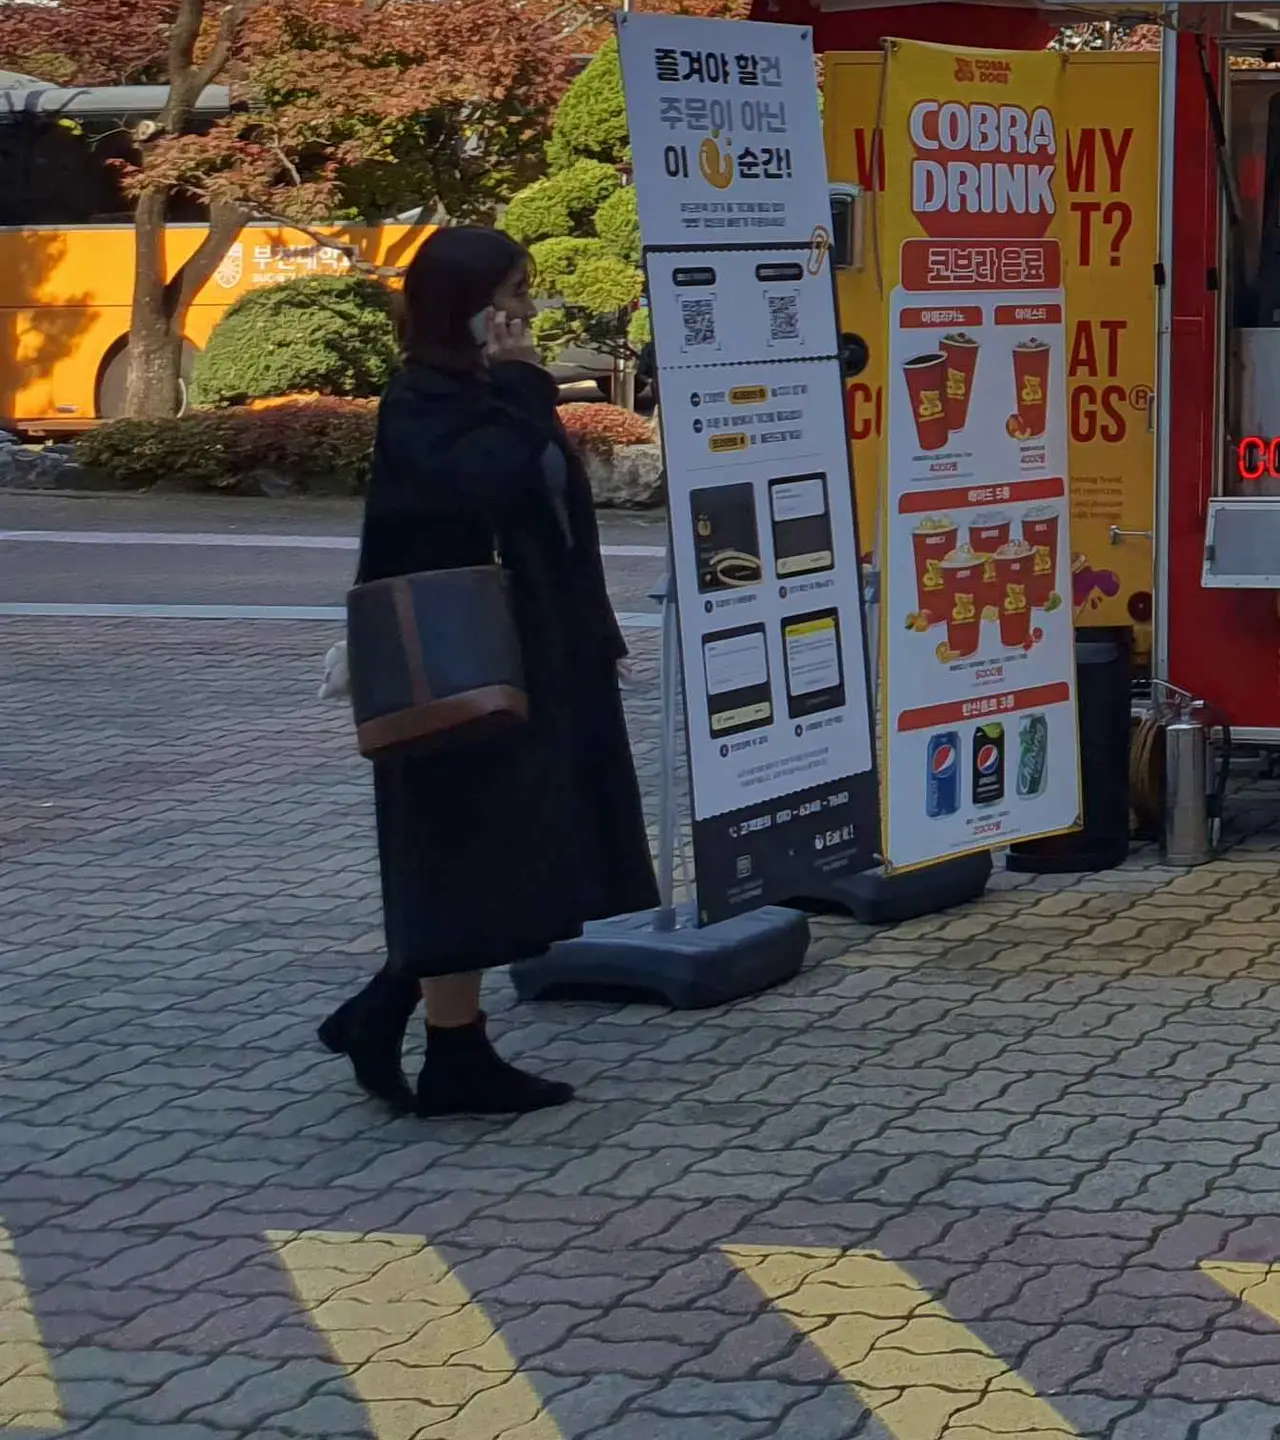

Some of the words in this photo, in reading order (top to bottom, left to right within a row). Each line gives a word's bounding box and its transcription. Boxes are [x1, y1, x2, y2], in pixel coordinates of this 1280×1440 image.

[655, 48, 730, 84] 즐겨야
[734, 54, 783, 87] 할건
[975, 59, 1011, 71] COBRA
[979, 71, 1009, 84] DOGS
[659, 96, 734, 132] 주문이
[741, 100, 787, 133] 아닌
[909, 100, 1057, 155] COBRA
[664, 145, 689, 178] 이
[737, 147, 792, 179] 순간!
[911, 159, 1057, 215] DRINK
[928, 248, 996, 283] 코브라
[1001, 248, 1045, 283] 음료
